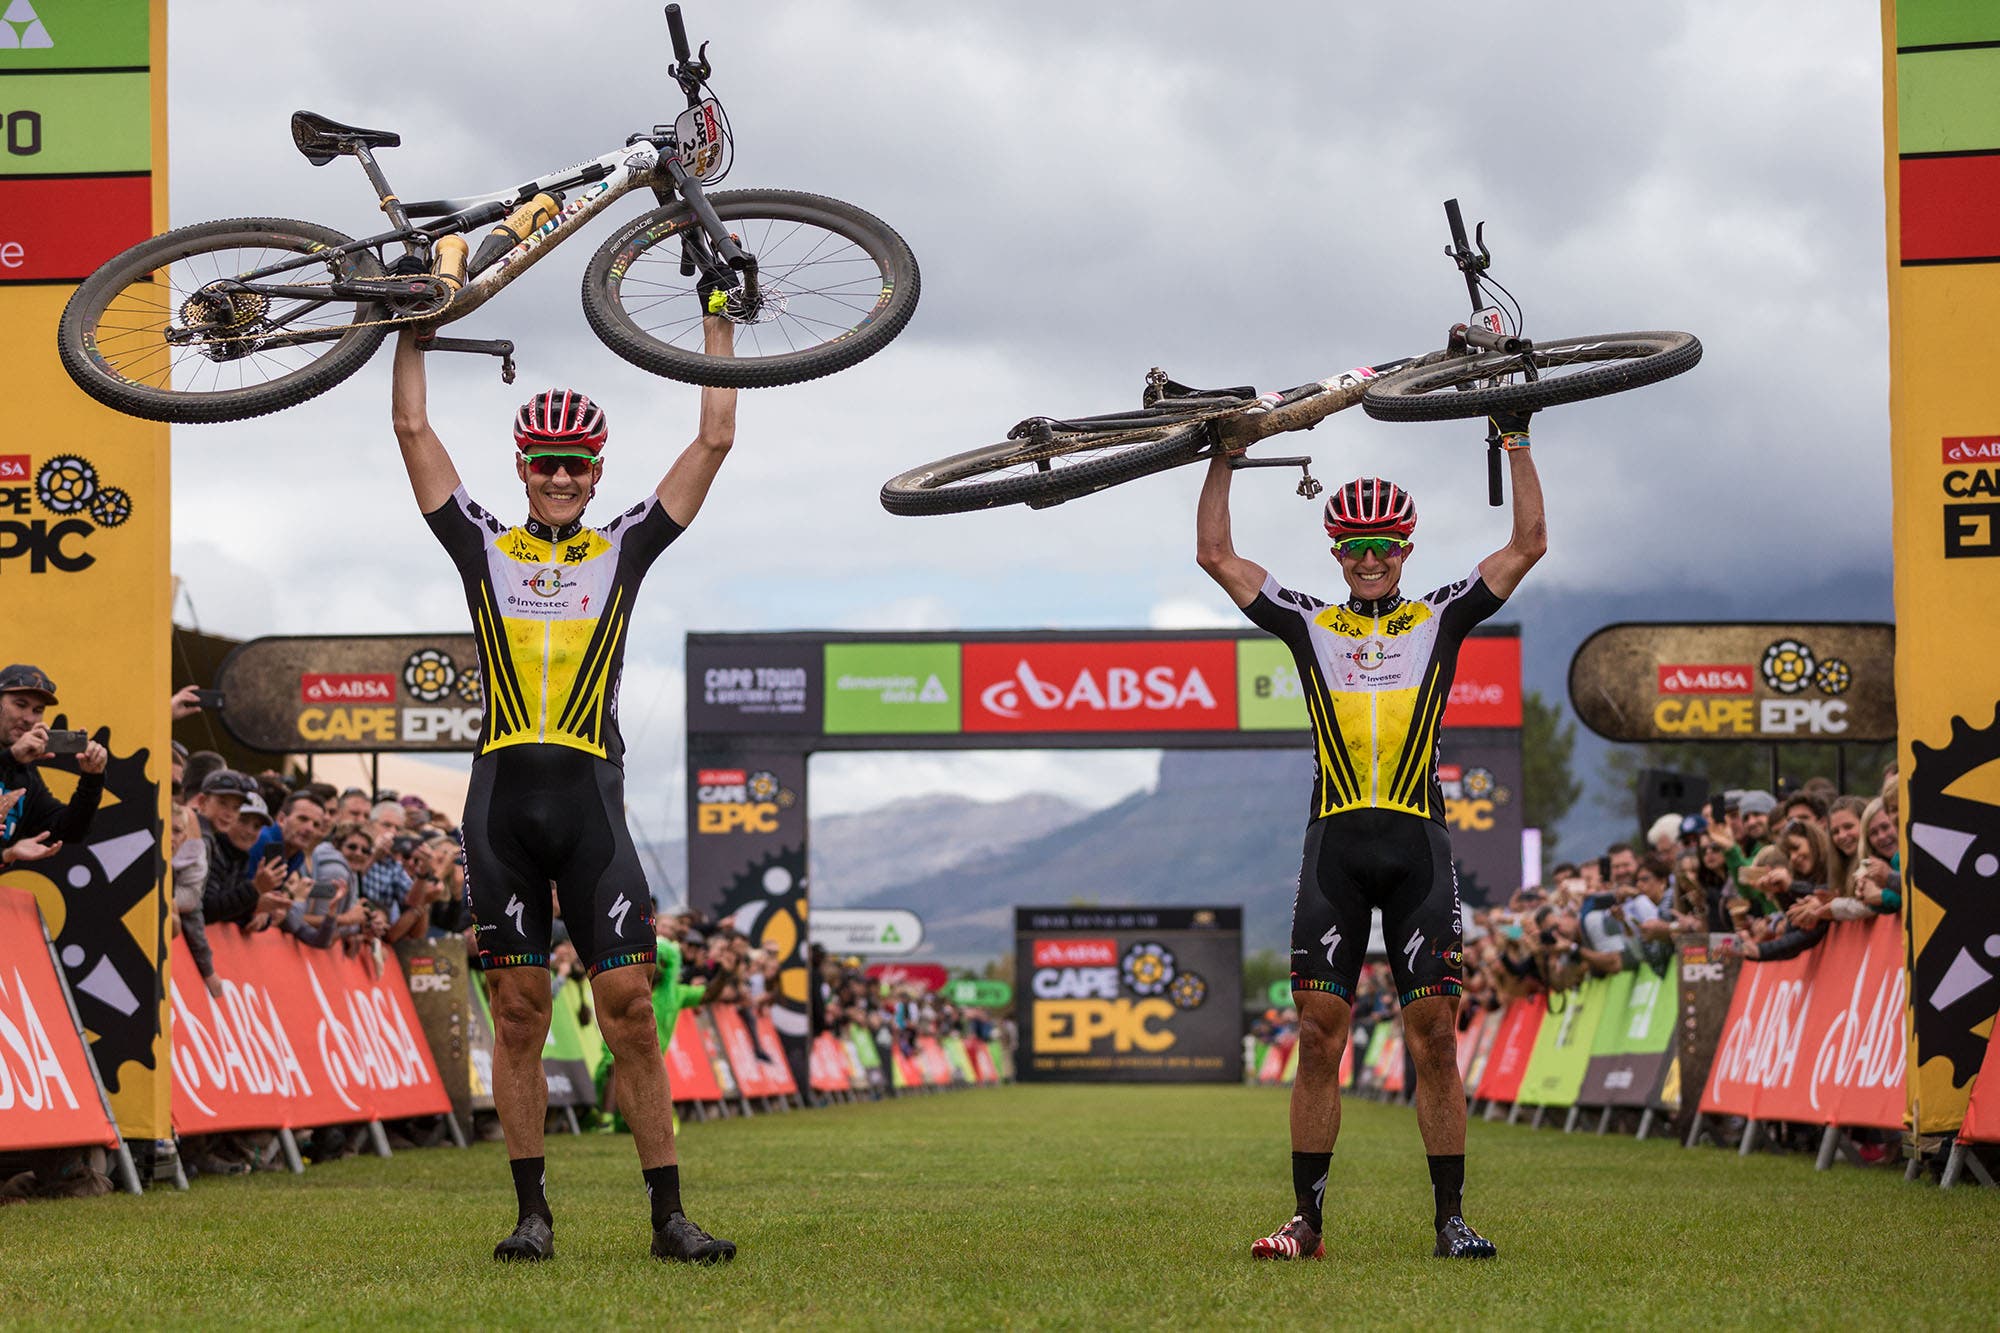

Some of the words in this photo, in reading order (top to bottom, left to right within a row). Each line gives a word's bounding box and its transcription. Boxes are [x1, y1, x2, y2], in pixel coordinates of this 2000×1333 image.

[0, 110, 41, 156] O
[693, 111, 708, 149] CAPE
[610, 216, 653, 254] RENEGADE
[0, 241, 25, 268] e
[0, 461, 25, 476] SA
[1944, 503, 2000, 559] E
[517, 598, 569, 609] Investec
[338, 680, 390, 697] ABSA
[1065, 665, 1218, 710] ABSA
[1367, 673, 1402, 682] Investec
[1693, 671, 1748, 689] ABSA
[297, 707, 396, 741] CAPE
[402, 707, 482, 742] EPIC
[1653, 699, 1754, 733] CAPE
[1760, 699, 1849, 734] EPIC
[698, 802, 779, 833] EPIC
[410, 974, 452, 992] EPIC
[1032, 967, 1119, 998] CAPE
[1683, 963, 1724, 981] EPIC
[206, 979, 313, 1098] ABSA
[345, 987, 431, 1090] ABSA
[1032, 998, 1177, 1053] EPIC
[1737, 979, 1815, 1089] ABSA
